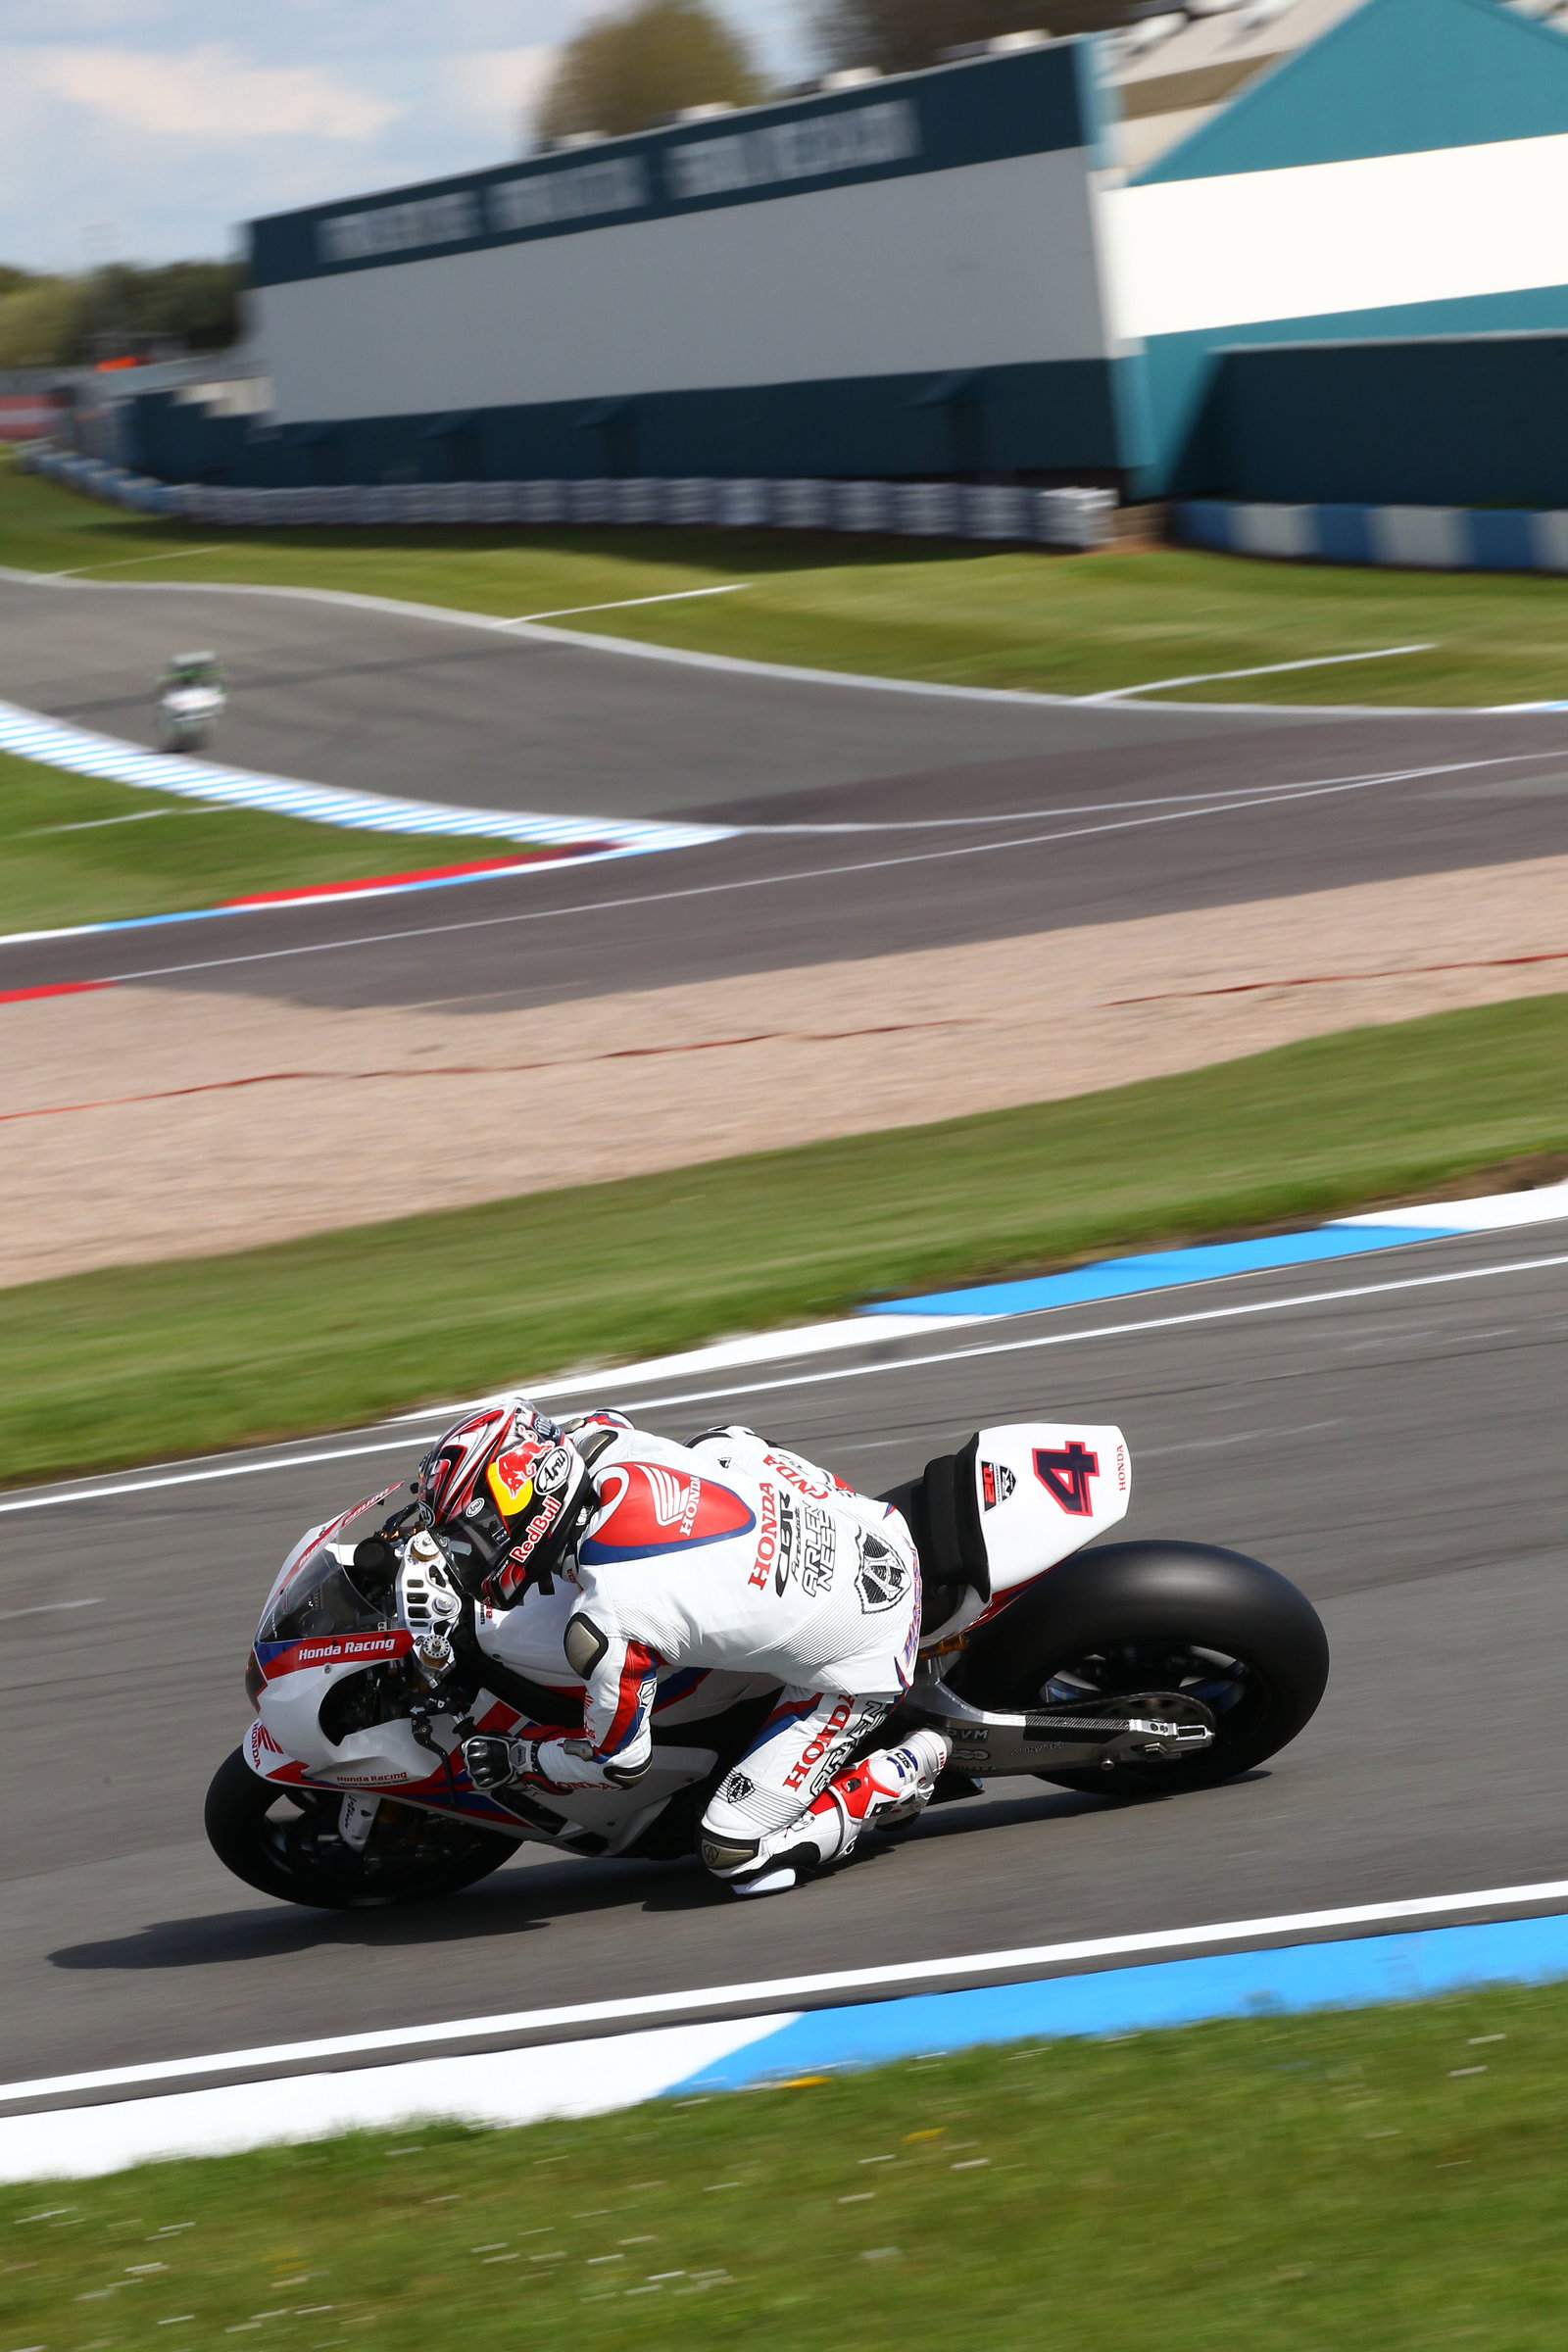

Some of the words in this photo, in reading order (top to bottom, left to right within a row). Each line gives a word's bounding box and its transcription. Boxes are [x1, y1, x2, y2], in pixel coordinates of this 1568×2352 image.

[1032, 1441, 1101, 1516] 4
[1117, 1445, 1126, 1492] HONDA
[680, 1477, 702, 1537] HONDA
[748, 1483, 777, 1591] HONDA
[298, 1643, 342, 1661] Honda
[344, 1638, 396, 1653] Racing
[250, 1722, 262, 1770] HONDA
[782, 1693, 856, 1791] HONDA
[370, 1772, 408, 1782] Racing
